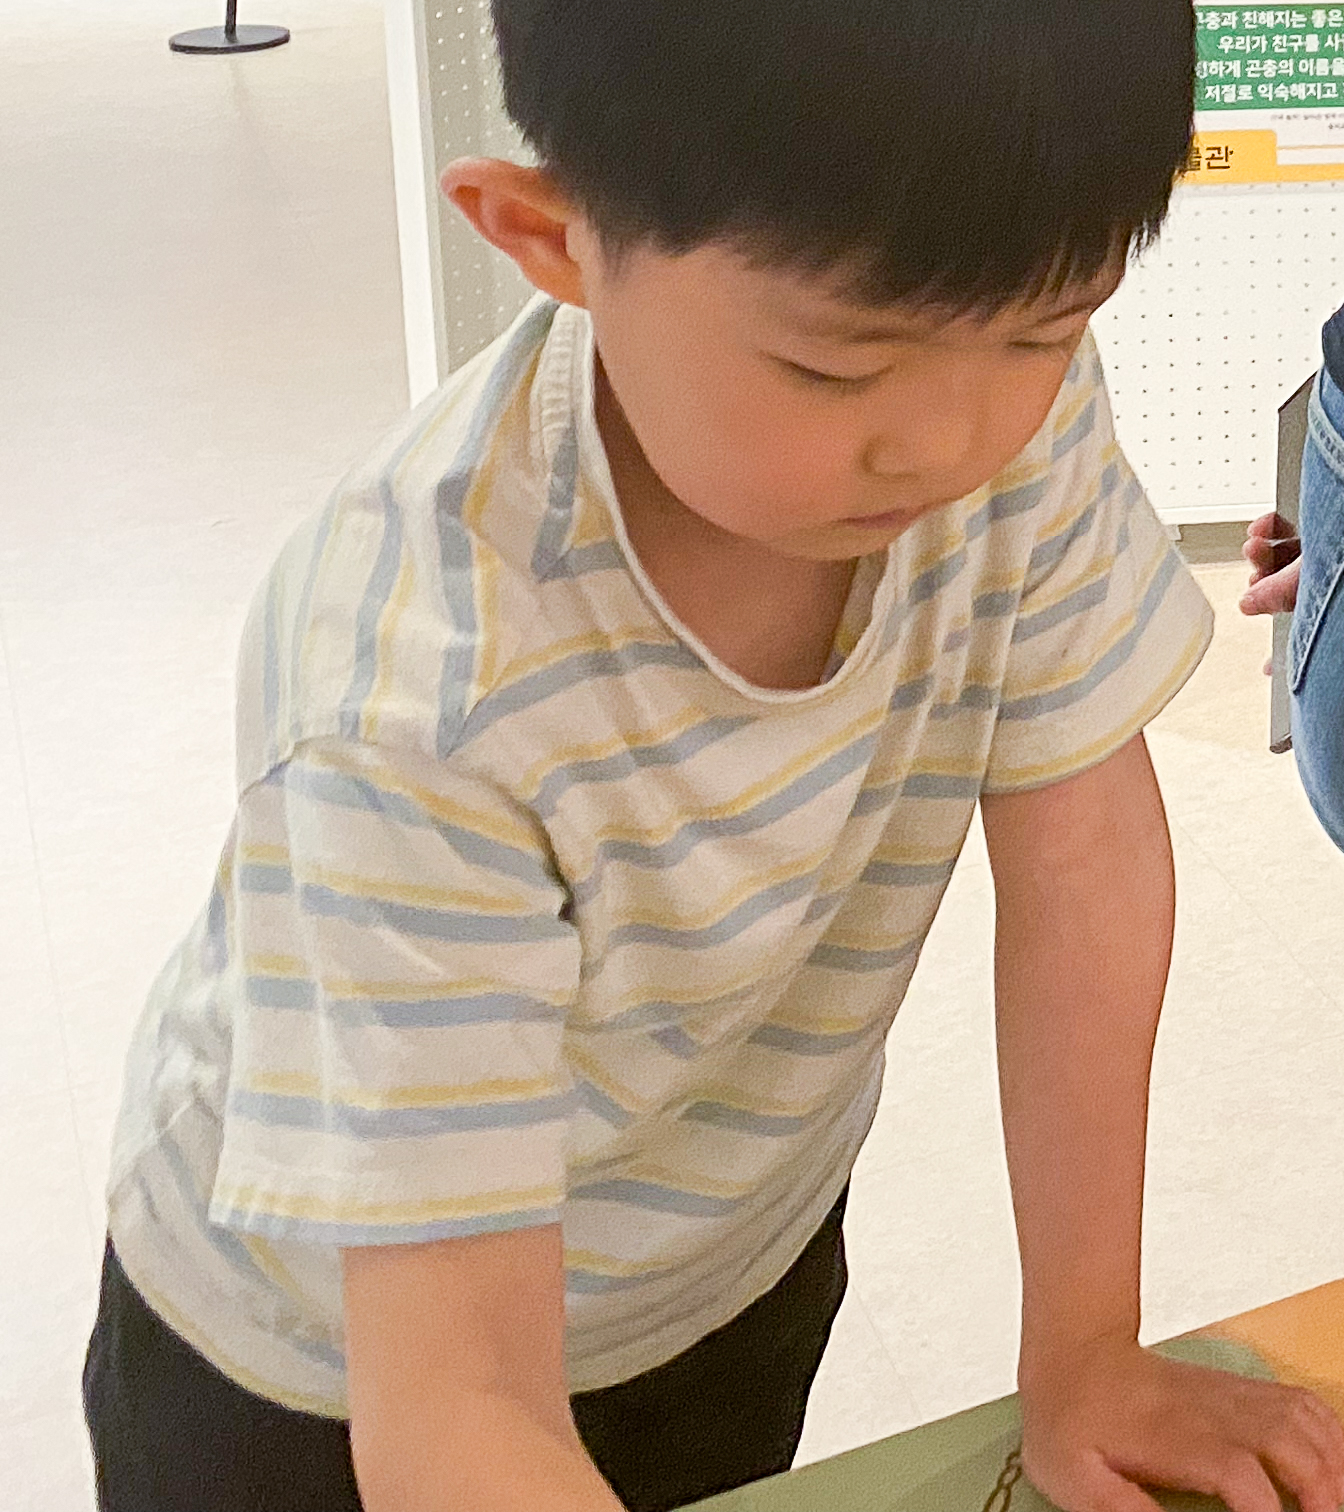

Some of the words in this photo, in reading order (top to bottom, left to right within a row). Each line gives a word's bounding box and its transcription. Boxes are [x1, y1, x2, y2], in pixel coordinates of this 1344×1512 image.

[1241, 9, 1307, 30] 친해지는
[1217, 35, 1269, 55] 우리가
[1272, 34, 1320, 54] 친구를
[1245, 59, 1294, 78] 곤충의
[1205, 83, 1253, 103] 저절로
[1256, 81, 1338, 102] 익숙해지고
